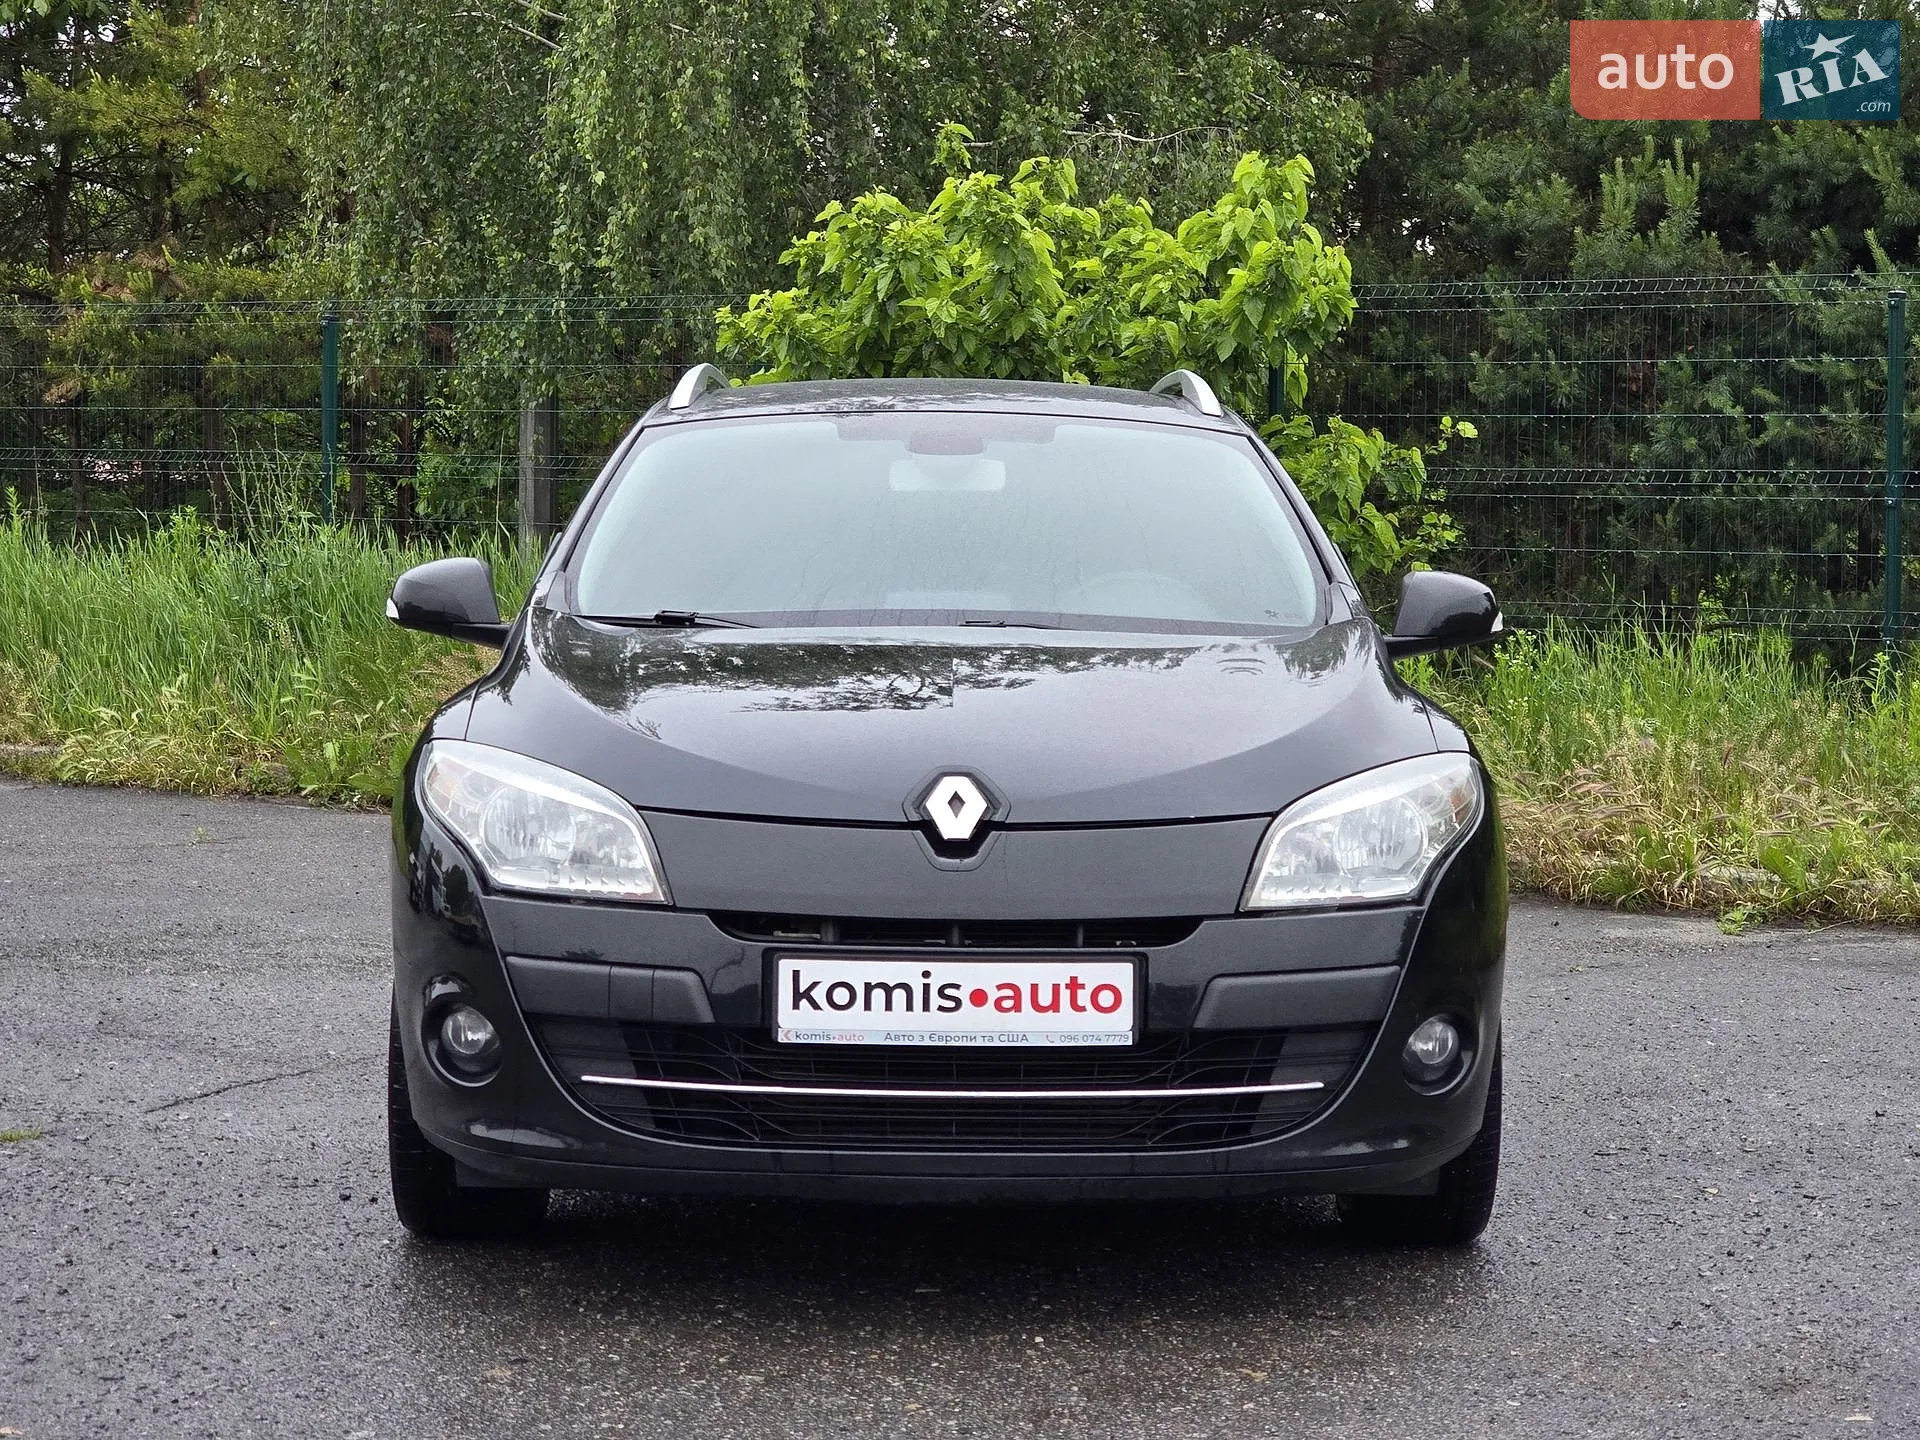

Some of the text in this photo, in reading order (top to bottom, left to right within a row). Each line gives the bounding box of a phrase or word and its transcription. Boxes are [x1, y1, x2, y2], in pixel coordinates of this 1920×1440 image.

[884, 1032, 1029, 1045] Авто з Європи та США
[1059, 1034, 1130, 1044] 096 074 7779
